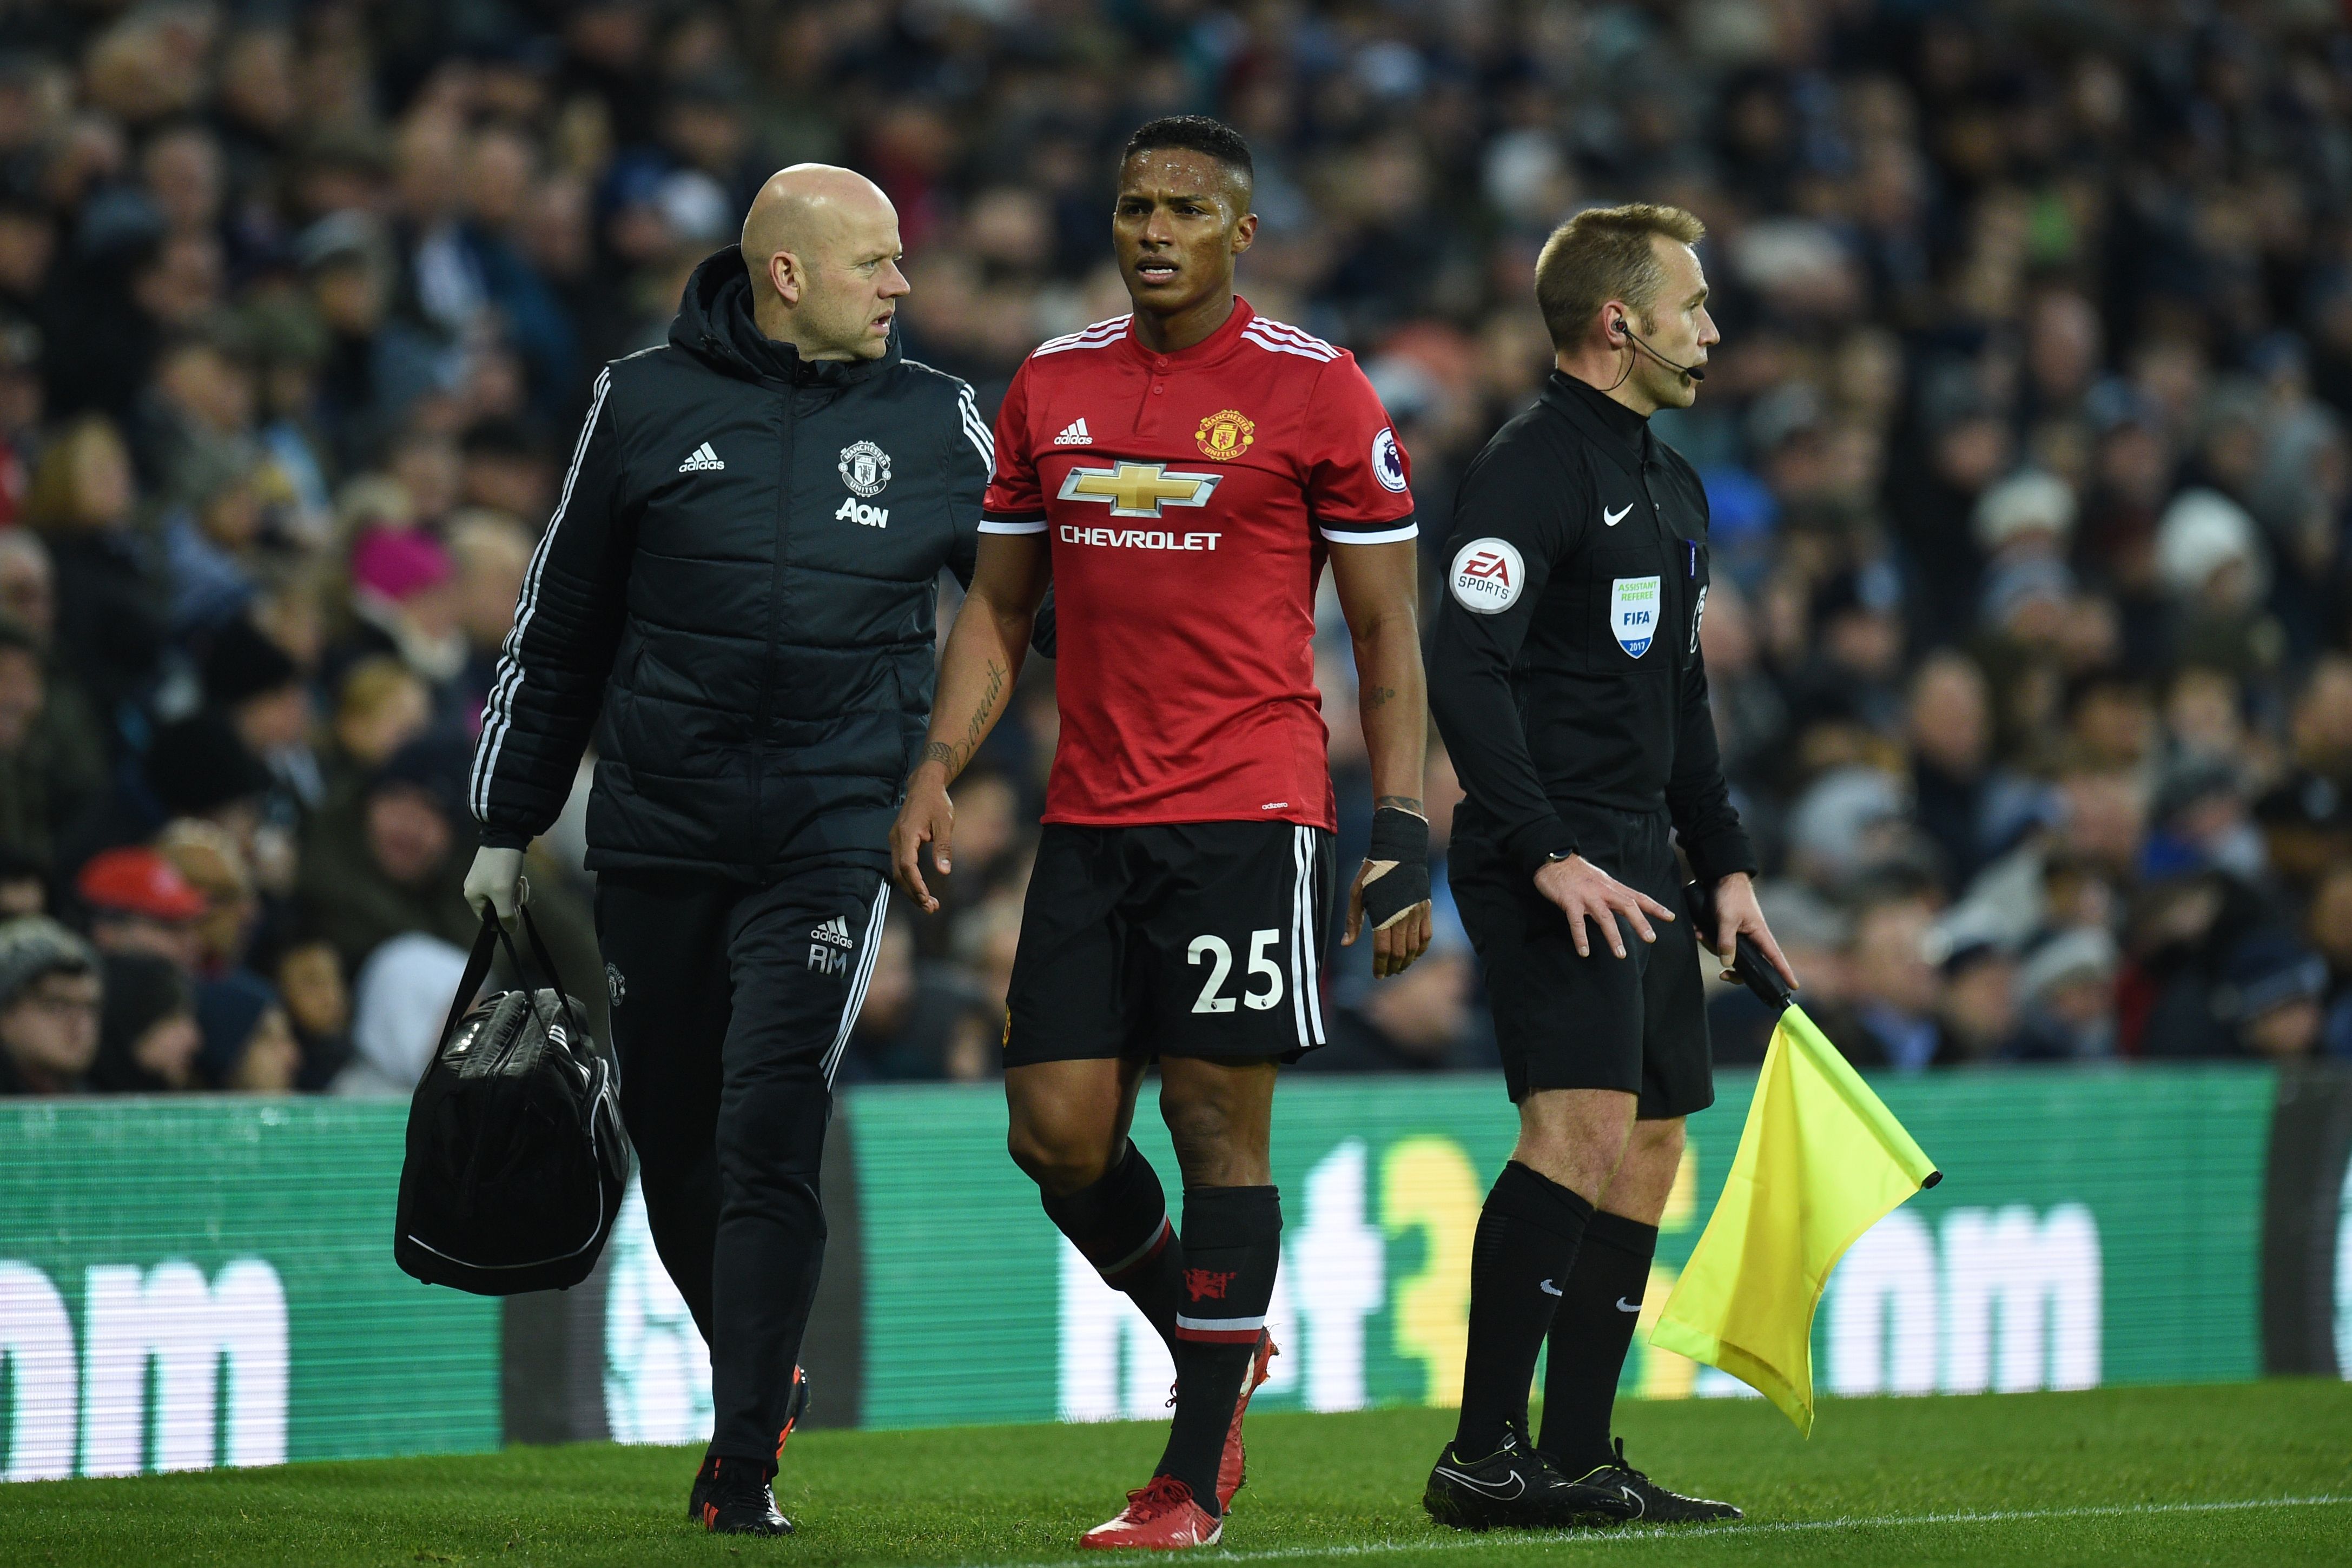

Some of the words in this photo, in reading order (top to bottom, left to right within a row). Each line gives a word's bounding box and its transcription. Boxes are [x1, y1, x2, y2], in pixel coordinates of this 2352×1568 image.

[1204, 413, 1250, 432] MANCHESTER
[1054, 434, 1093, 445] adidas
[844, 445, 887, 467] MANCHESTER
[1205, 447, 1238, 457] UNITED
[678, 459, 725, 473] adidas
[850, 481, 879, 493] UNITED
[835, 497, 889, 528] AON
[1060, 525, 1222, 551] CHEVROLET
[1462, 551, 1510, 588] EA
[1458, 575, 1510, 600] SPORTS
[1618, 580, 1657, 591] ASSISTANT
[1621, 591, 1654, 601] REFEREE
[1623, 611, 1650, 626] FIFA
[1629, 641, 1646, 652] 2017
[810, 929, 853, 949] adidas
[807, 944, 848, 979] RM
[1187, 928, 1284, 1013] 25
